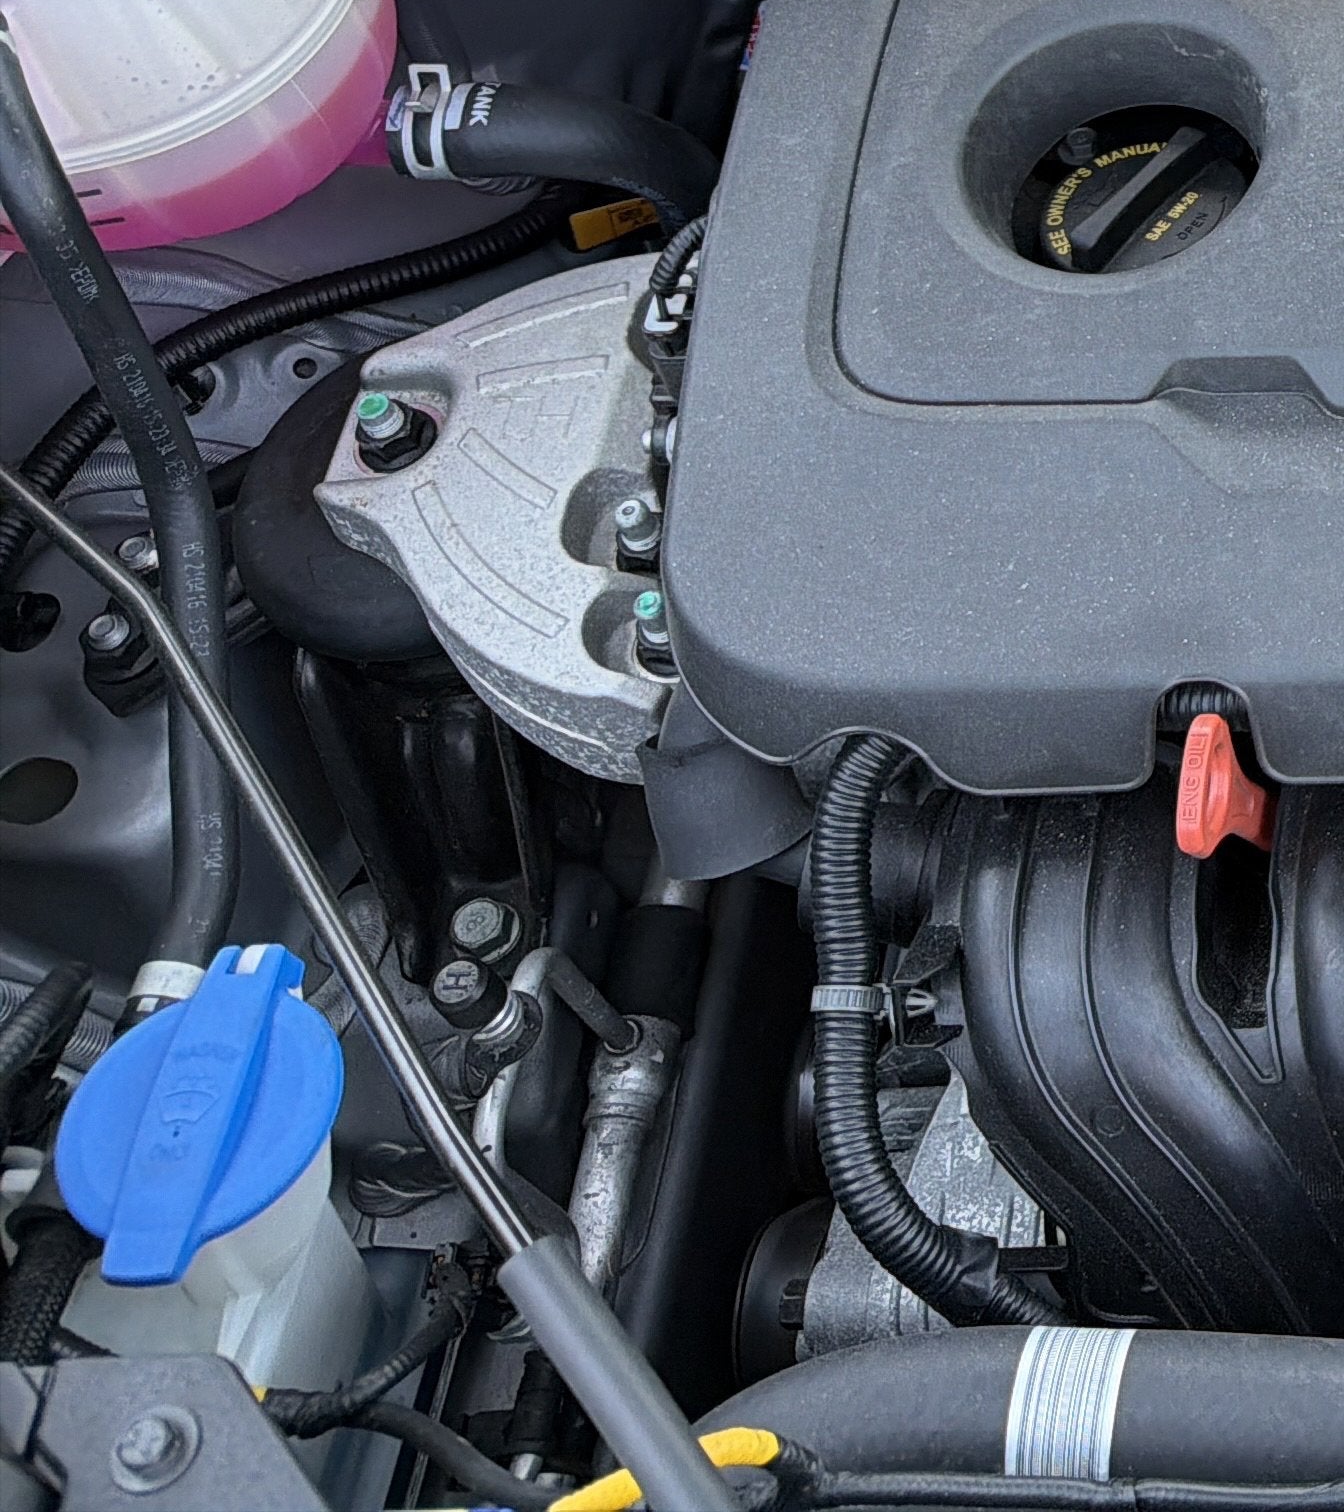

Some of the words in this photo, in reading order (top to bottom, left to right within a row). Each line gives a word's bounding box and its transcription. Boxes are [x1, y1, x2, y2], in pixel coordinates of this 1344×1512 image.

[1093, 142, 1168, 168] MANUA
[1046, 167, 1092, 226] OWNER'S
[1144, 219, 1171, 241] SAE
[1168, 191, 1198, 220] 5W-20
[1175, 211, 1208, 241] OPEN
[1049, 228, 1072, 256] SEE
[1188, 733, 1209, 768] OIL
[1181, 776, 1200, 824] ENG
